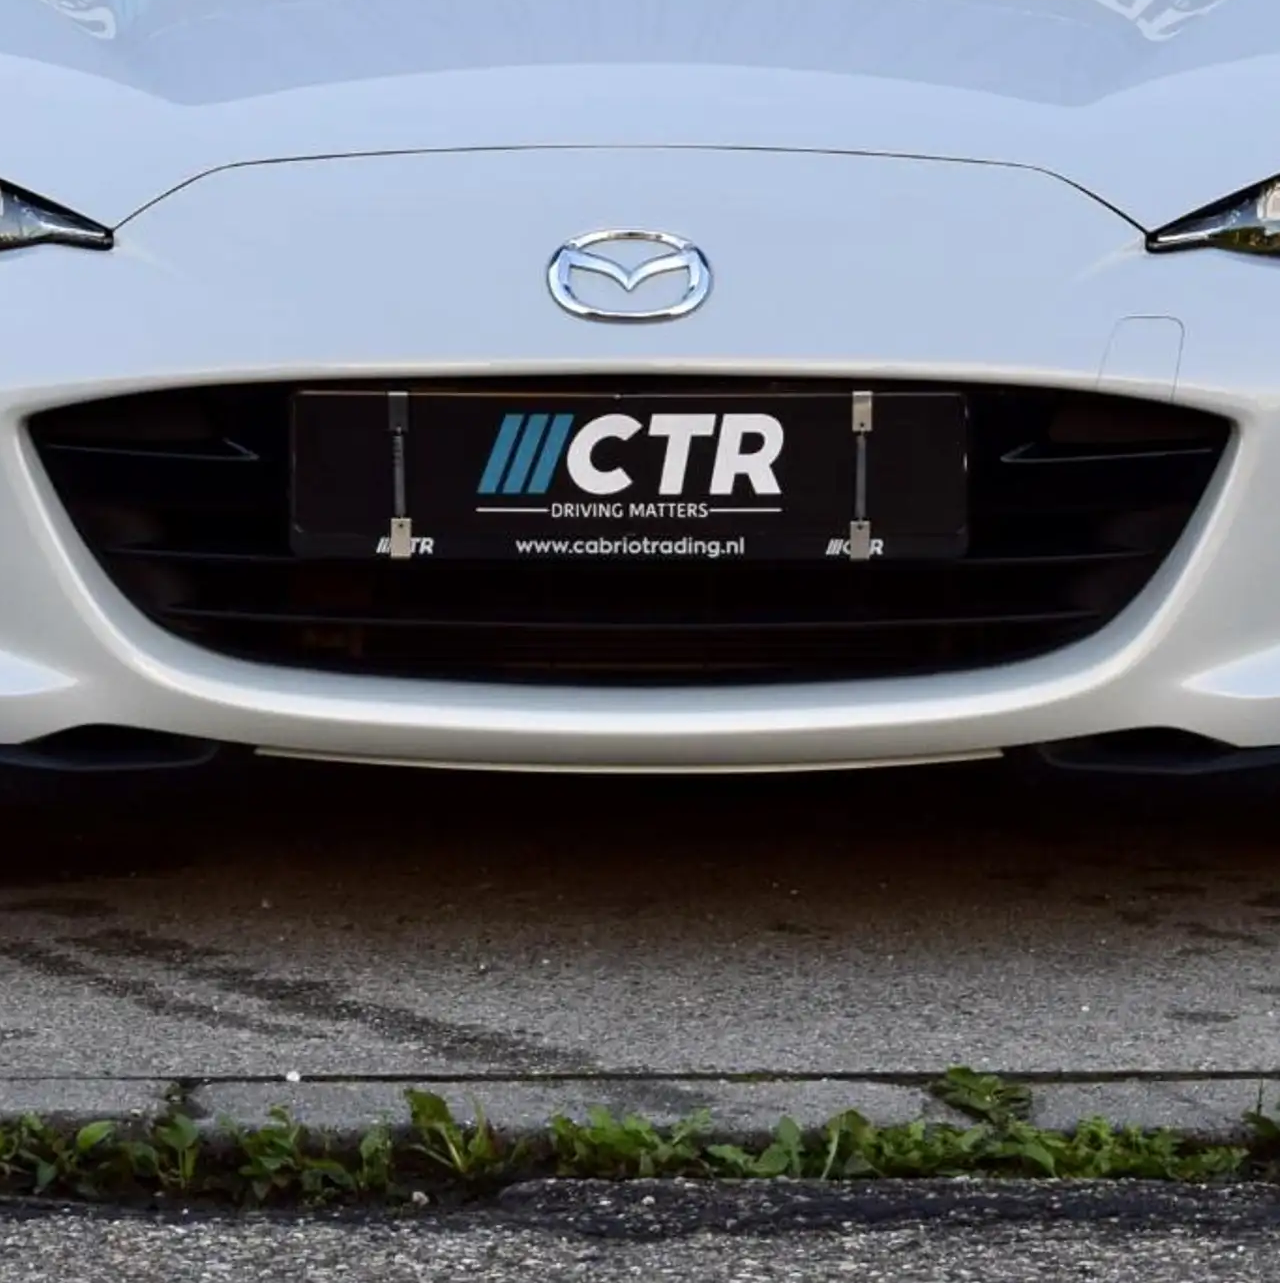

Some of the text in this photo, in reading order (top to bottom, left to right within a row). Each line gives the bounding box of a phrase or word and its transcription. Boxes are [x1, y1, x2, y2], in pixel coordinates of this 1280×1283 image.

[567, 413, 784, 495] CTR
[551, 502, 709, 518] DRIVING MATTERS
[515, 536, 745, 559] www.cabriotrading.nl
